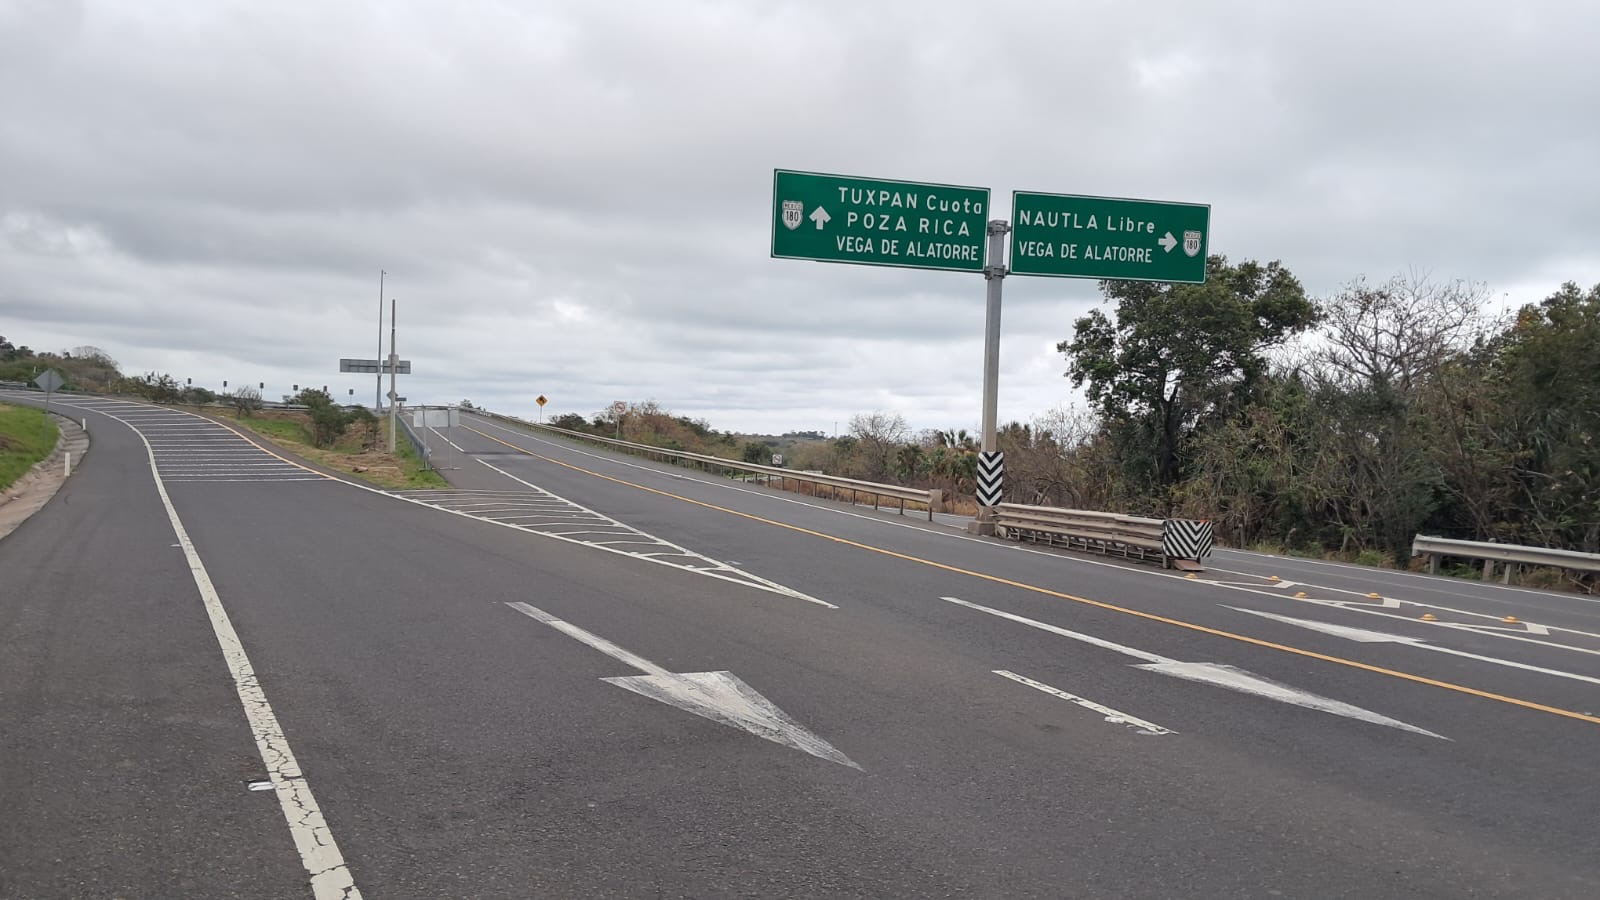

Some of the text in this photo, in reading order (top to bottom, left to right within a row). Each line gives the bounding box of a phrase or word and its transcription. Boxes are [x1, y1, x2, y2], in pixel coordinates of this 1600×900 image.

[838, 186, 982, 215] TUXPAN Cuota
[786, 211, 799, 222] 180
[847, 212, 970, 237] POZA RICA
[1019, 210, 1155, 233] NAUTLA Libre
[837, 235, 979, 261] VEGA DE ALATORRE
[1019, 241, 1153, 263] VEGA DE ALATORRE
[1186, 239, 1198, 250] 180
